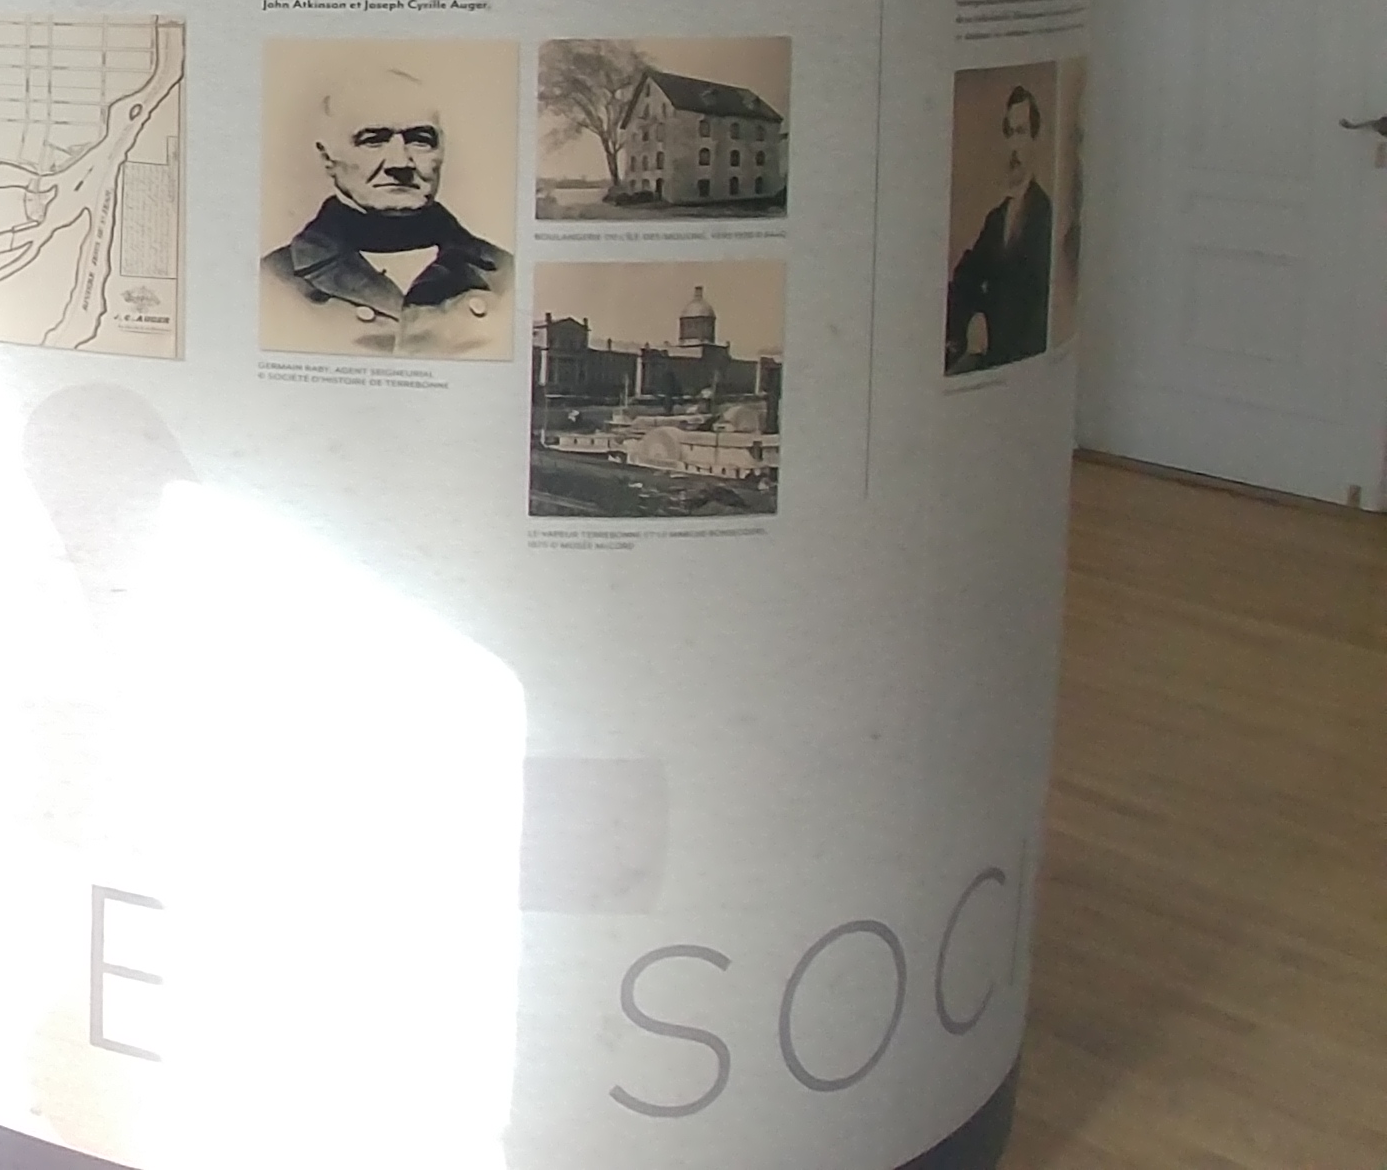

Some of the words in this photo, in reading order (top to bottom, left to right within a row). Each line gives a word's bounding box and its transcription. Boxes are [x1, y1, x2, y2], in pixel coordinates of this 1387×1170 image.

[263, 0, 290, 11] John
[293, 0, 347, 8] Atkinson
[364, 0, 405, 11] Joseph
[408, 0, 447, 11] Cyrille
[257, 361, 303, 372] GERMAIN
[334, 366, 367, 376] AGENT
[369, 378, 382, 388] DE
[385, 380, 450, 391] TERREBONNE
